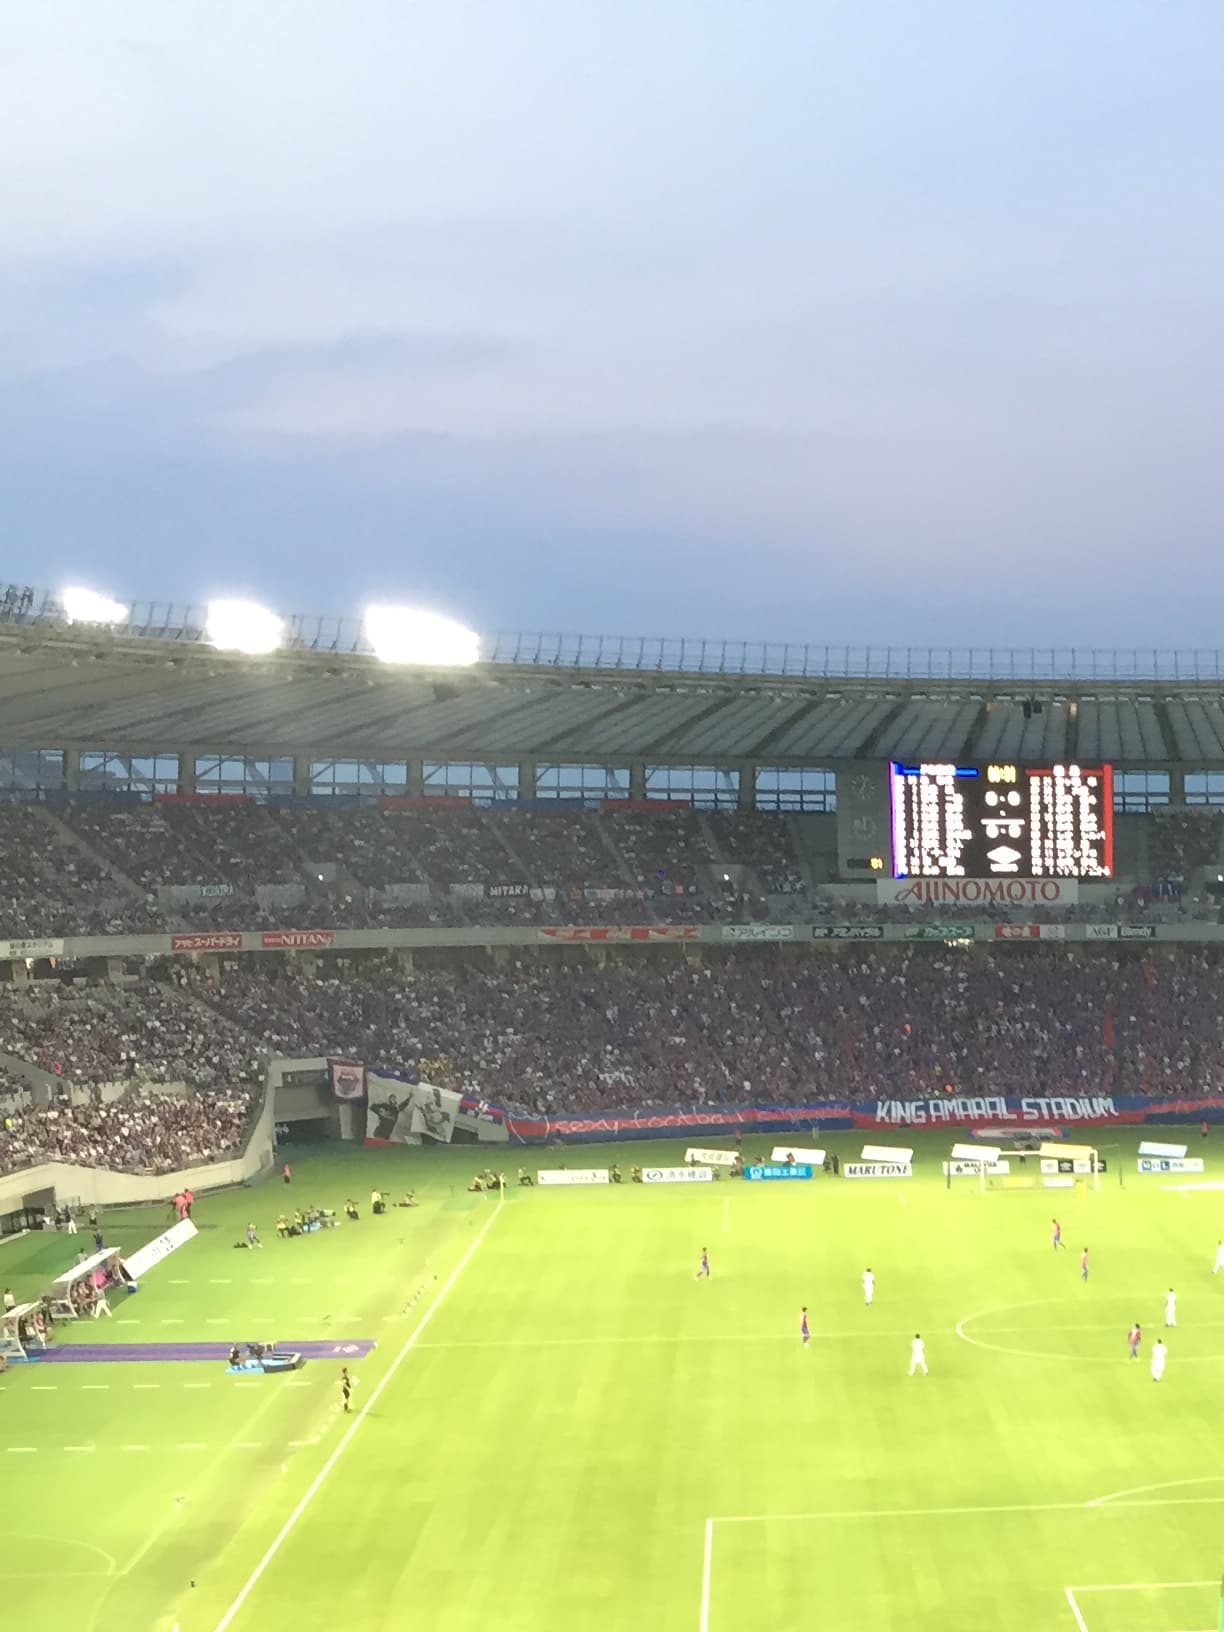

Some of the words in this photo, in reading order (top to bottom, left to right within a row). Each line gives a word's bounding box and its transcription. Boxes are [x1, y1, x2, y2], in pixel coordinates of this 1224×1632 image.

[281, 933, 326, 945] NITTAN
[875, 1098, 928, 1124] KING
[930, 1097, 1018, 1122] AMARAL
[1021, 1097, 1119, 1121] STADIUM
